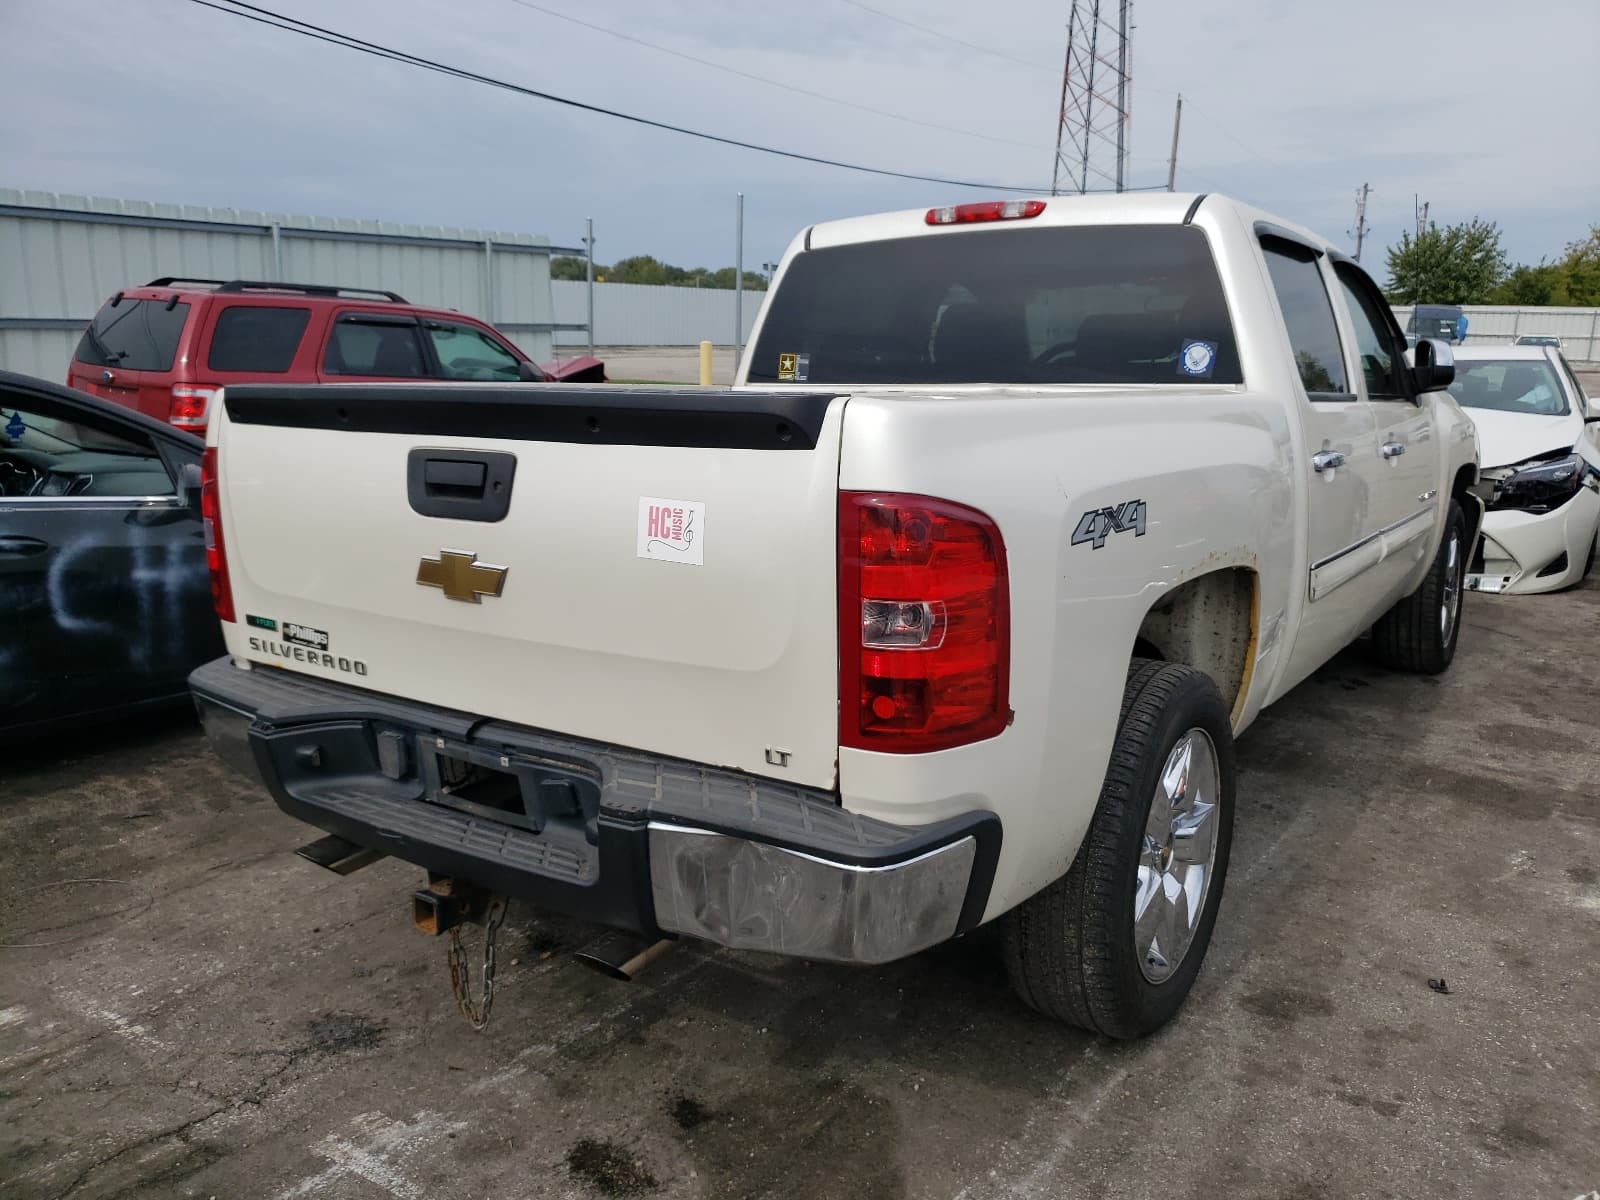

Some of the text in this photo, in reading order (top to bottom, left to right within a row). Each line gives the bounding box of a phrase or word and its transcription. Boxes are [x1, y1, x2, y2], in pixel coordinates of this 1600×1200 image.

[647, 505, 671, 539] HC
[672, 507, 684, 541] MUSIC
[289, 623, 328, 646] Phillips
[249, 637, 368, 677] SILVERADO
[765, 748, 792, 768] LT
